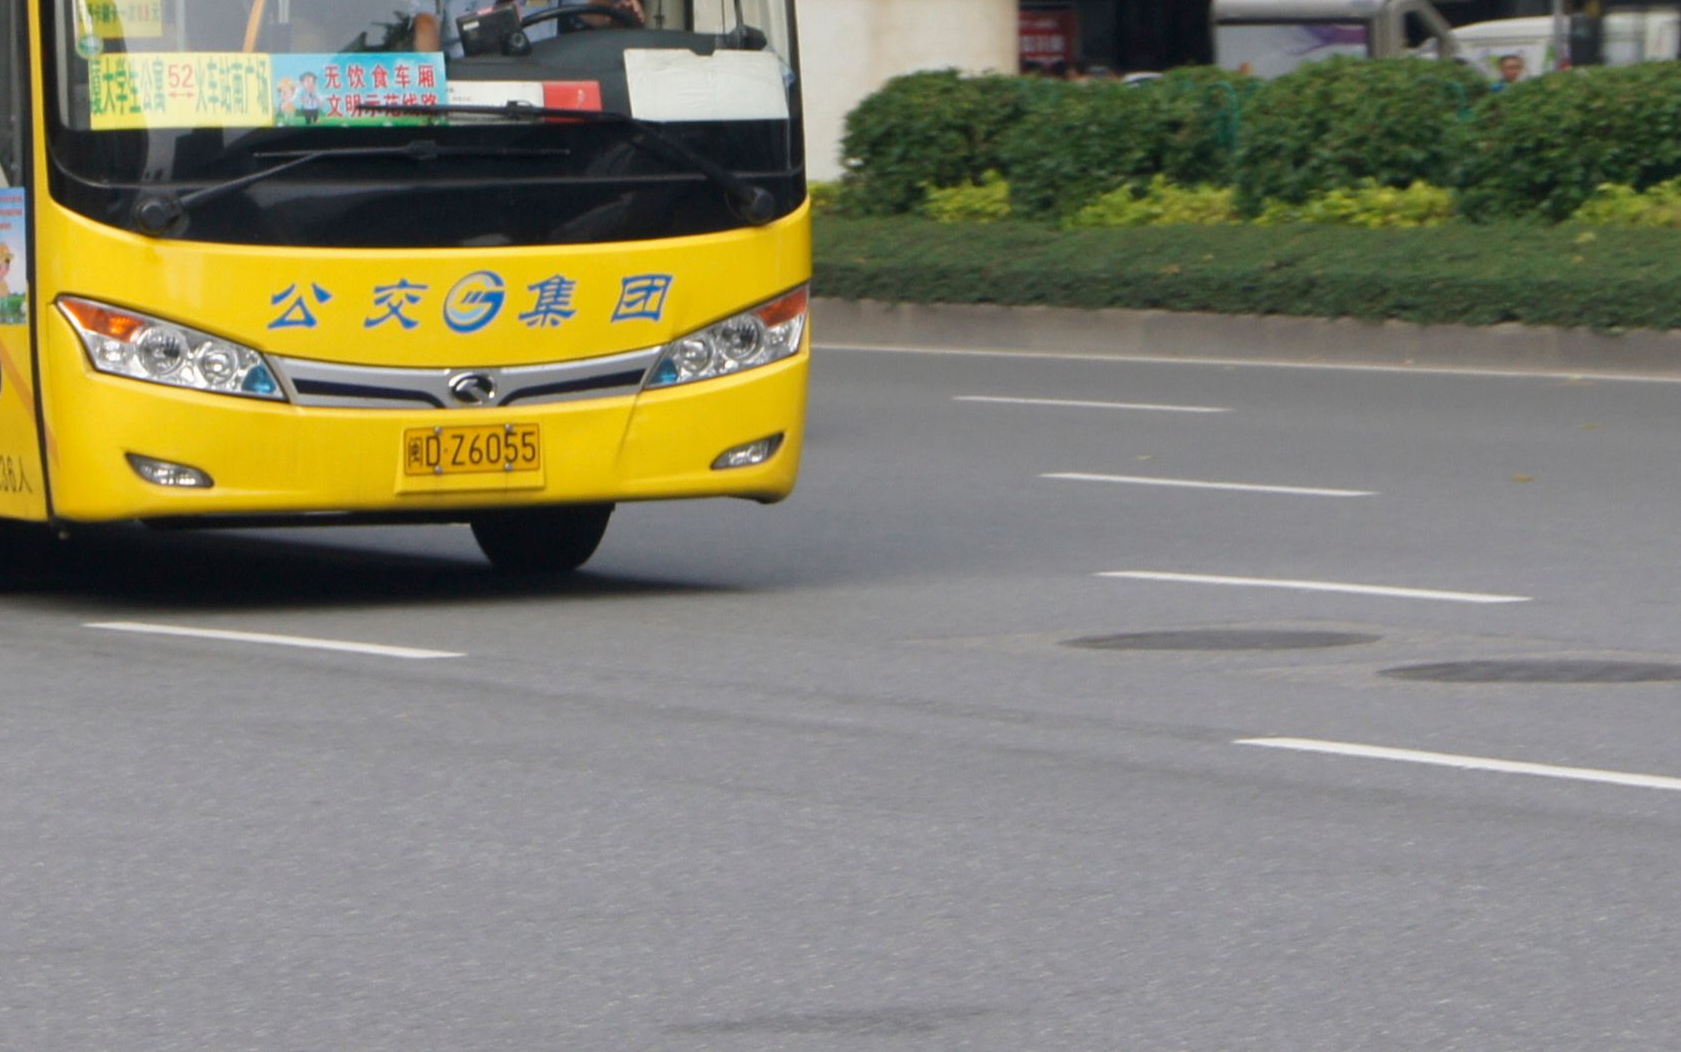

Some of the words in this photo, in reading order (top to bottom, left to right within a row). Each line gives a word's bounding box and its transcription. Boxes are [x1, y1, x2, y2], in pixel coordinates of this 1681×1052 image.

[168, 64, 195, 89] 52
[195, 58, 270, 115] 火车站南广场
[324, 64, 437, 89] 无饮食车厢
